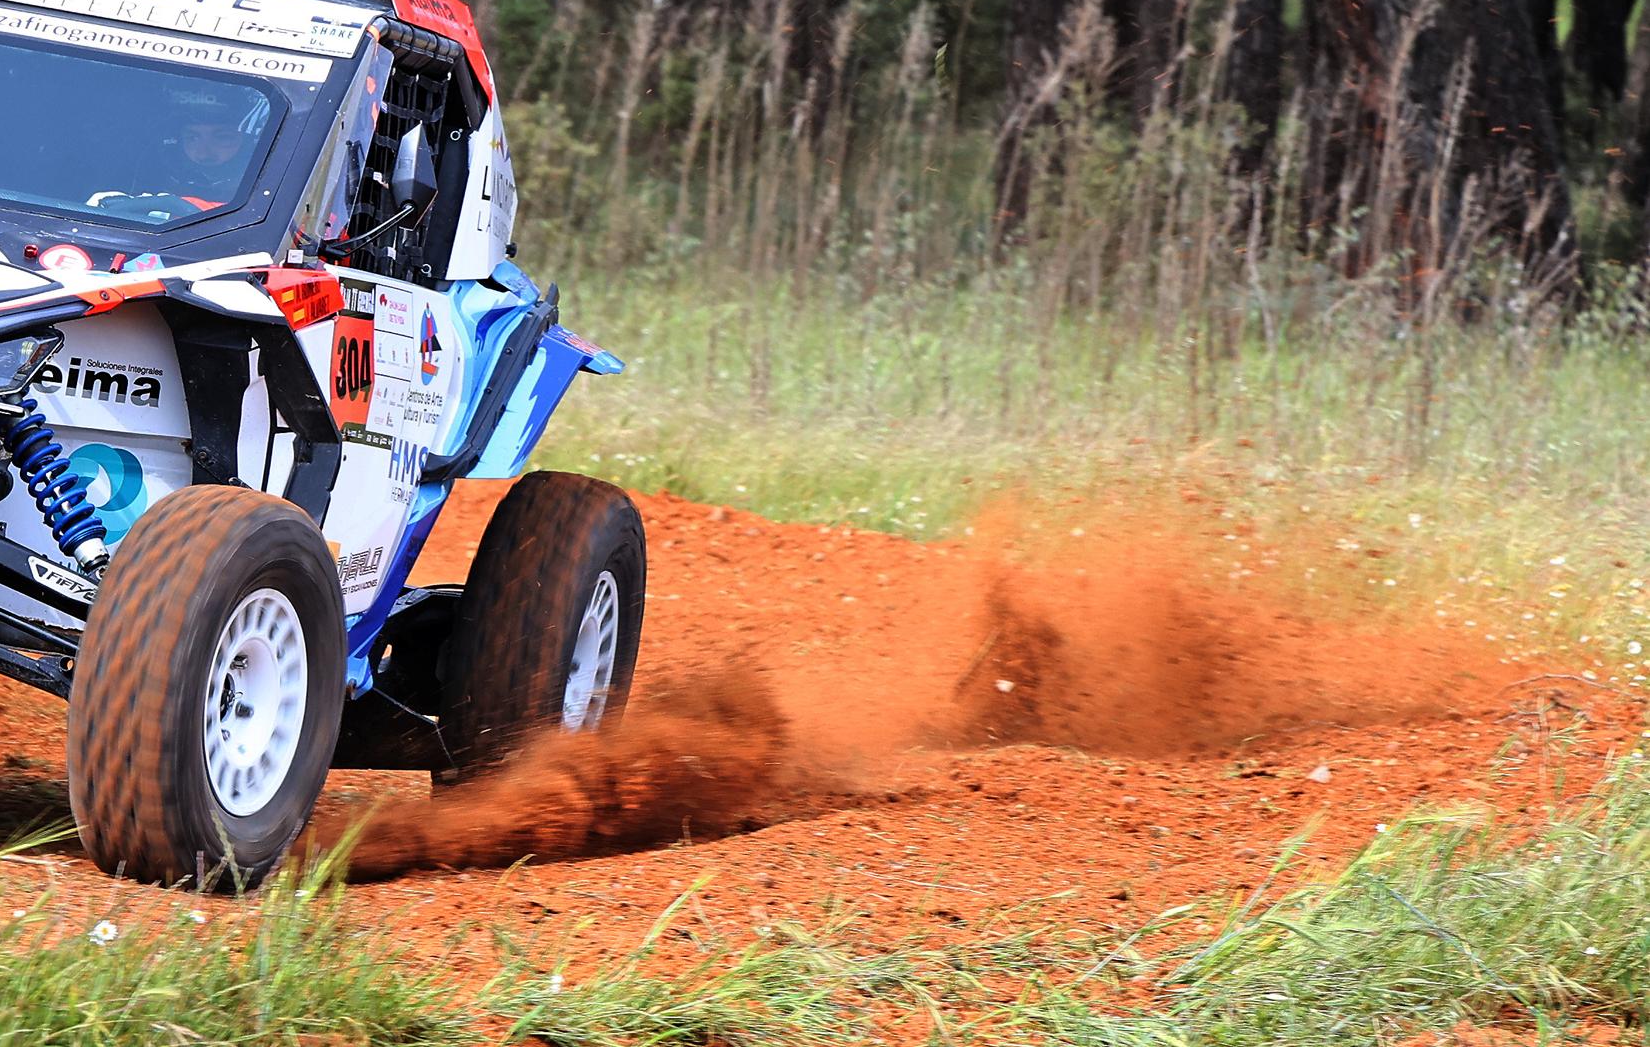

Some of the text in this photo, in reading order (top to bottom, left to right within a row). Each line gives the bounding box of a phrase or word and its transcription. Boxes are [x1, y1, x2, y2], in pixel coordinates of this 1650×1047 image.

[311, 26, 355, 40] SHAKE
[86, 359, 164, 376] Soluciones Integrales
[336, 336, 372, 402] 304
